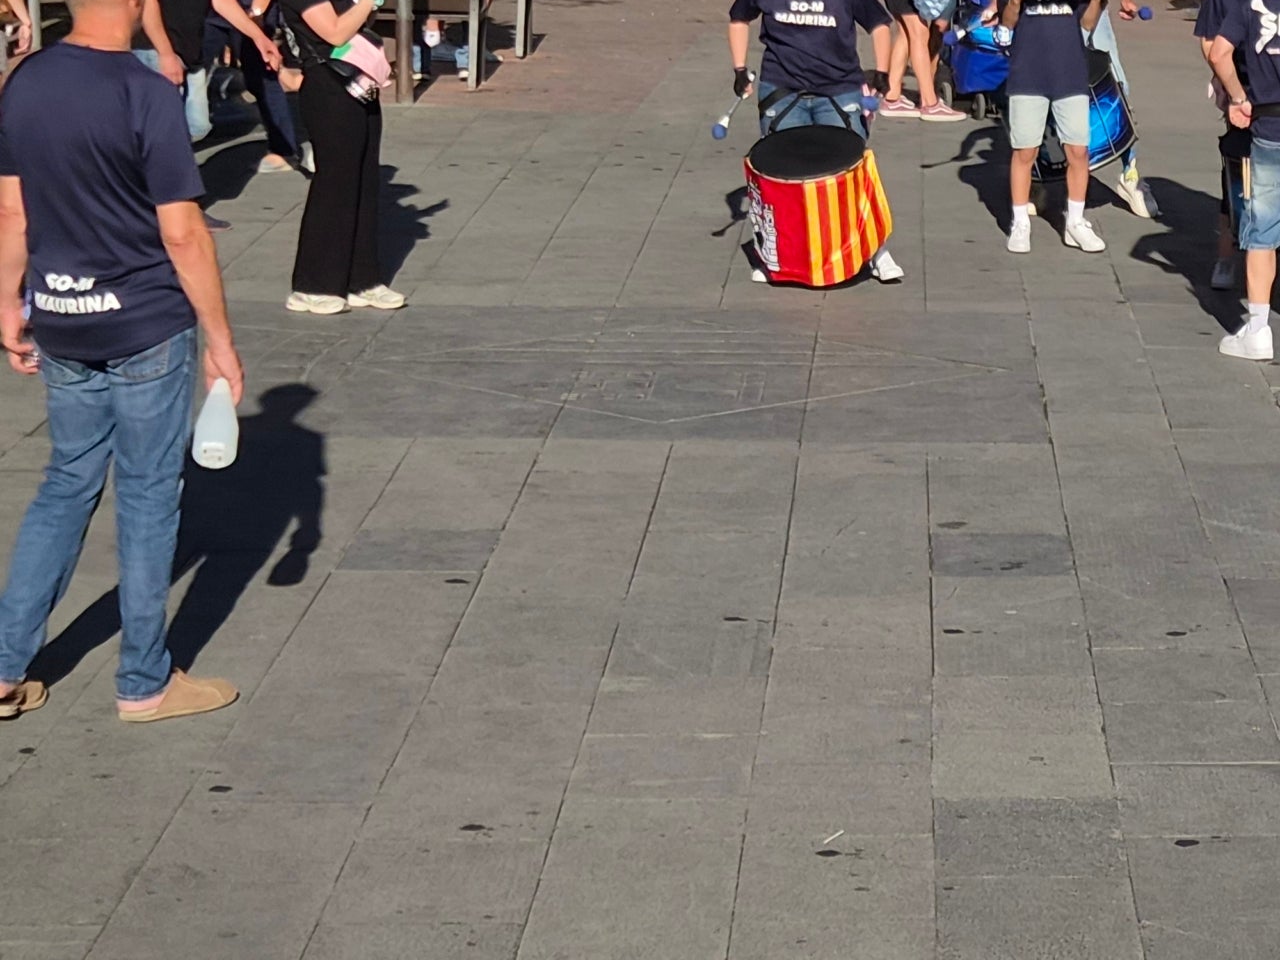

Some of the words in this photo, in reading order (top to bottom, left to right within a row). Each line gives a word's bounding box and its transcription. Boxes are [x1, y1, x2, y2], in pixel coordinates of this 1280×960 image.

[790, 0, 824, 13] SO-M
[774, 12, 837, 27] MAURINA
[34, 291, 122, 315] MAURINA
